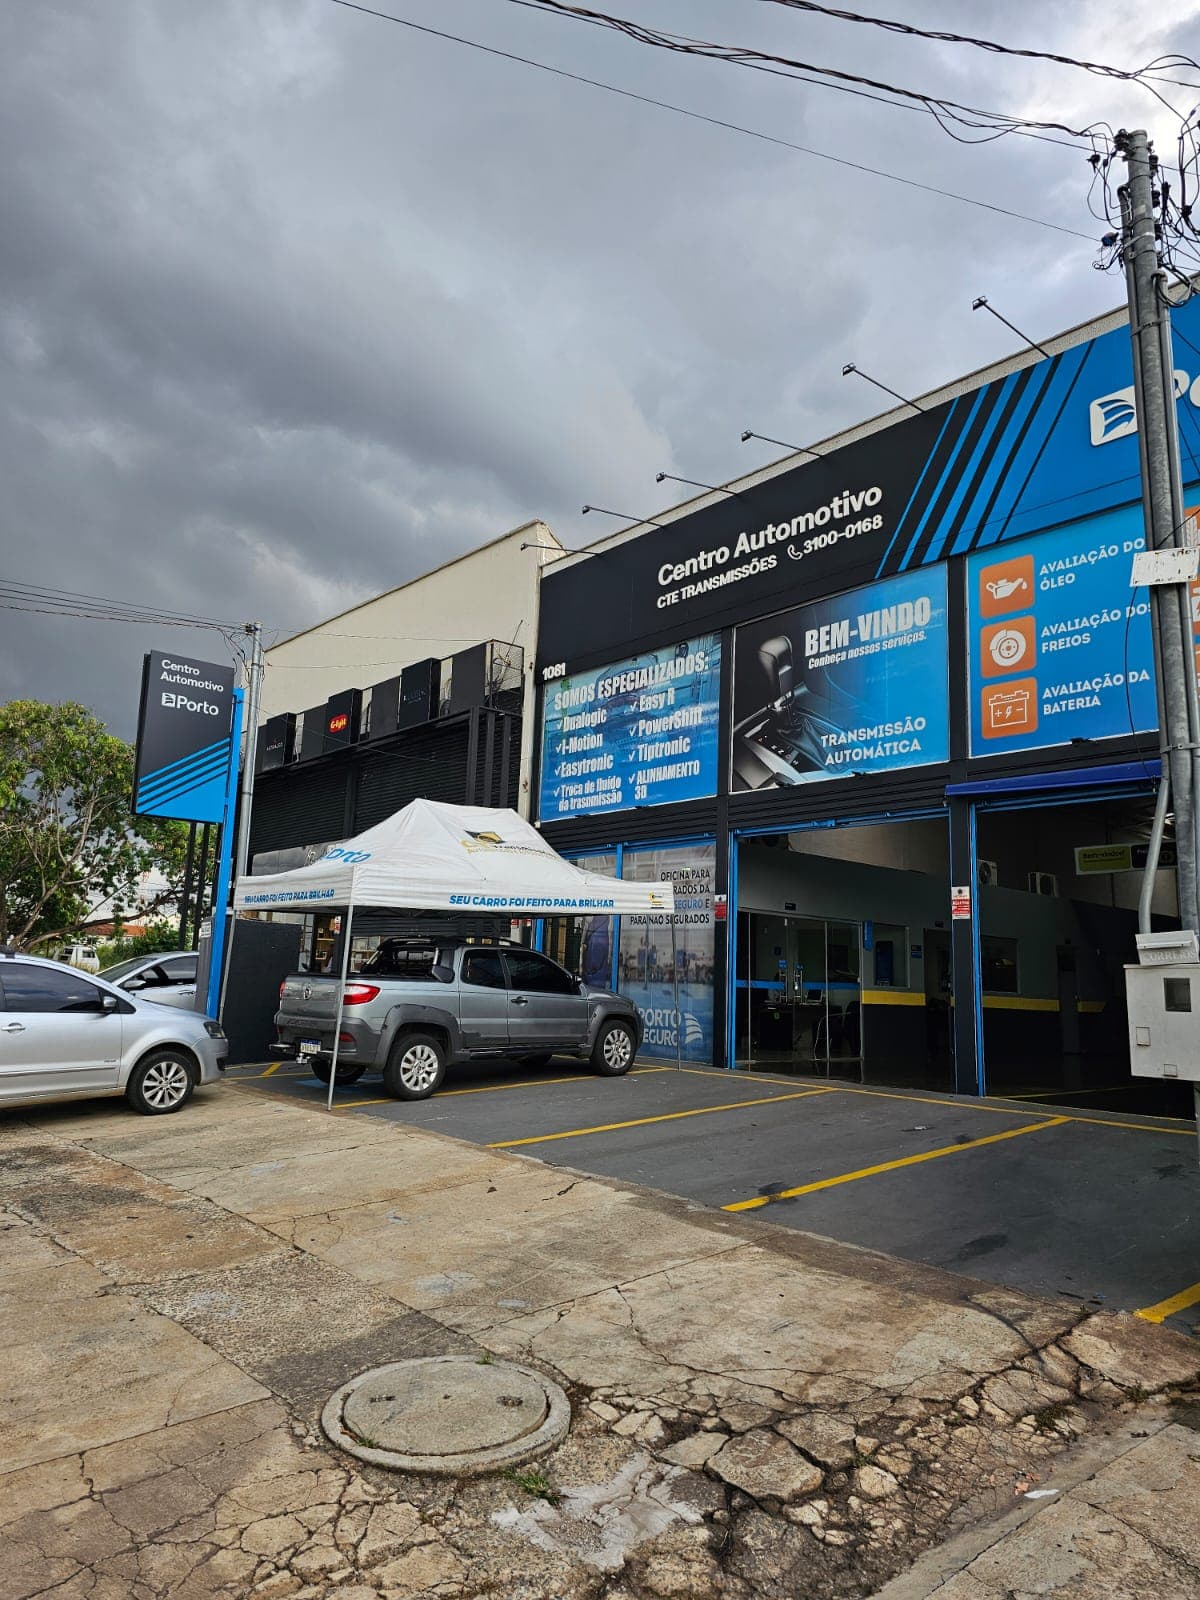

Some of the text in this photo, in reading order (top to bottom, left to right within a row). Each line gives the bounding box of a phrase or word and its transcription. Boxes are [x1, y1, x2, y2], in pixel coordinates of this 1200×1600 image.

[658, 486, 882, 585] Centro Automotivo
[657, 515, 883, 609] CTE TRANSMISSÕES 3100-0168
[1040, 537, 1145, 576] AVALIAÇÃO DO
[1040, 573, 1076, 591] ÓLEO
[805, 596, 931, 657] BEM-VINDO
[1041, 609, 1121, 638] AVALIAÇÃO
[808, 630, 927, 670] Conheça nossos serviços.
[1041, 633, 1091, 653] FREIOS
[161, 659, 200, 675] Centro
[542, 662, 566, 681] 1081
[160, 671, 224, 692] Automotivo
[554, 651, 709, 711] SOMOS ESPECIALIZADOS:
[1043, 669, 1150, 700] AVALIAÇÃO DA
[176, 695, 219, 716] Porto
[639, 687, 675, 712] Easy R
[1043, 695, 1101, 715] BATERIA
[563, 708, 607, 732] Dualogic
[638, 706, 703, 737] PowerShift
[821, 716, 926, 748] TRANSMISSÃO
[638, 736, 690, 762] Tiptronic
[825, 738, 922, 766] AUTOMÁTICA
[561, 753, 613, 778] Easytronic
[637, 760, 700, 785] ALINHAMENTO
[561, 783, 583, 798] Troca
[585, 781, 595, 795] de
[635, 785, 647, 800] 3D
[559, 798, 569, 812] da
[661, 869, 710, 881] OFICINA PARA
[673, 884, 710, 895] RADOS DA
[449, 895, 614, 908] SEU CARRO FOI FEITO PARA BRILHAR
[674, 898, 702, 909] SEGURO
[705, 898, 710, 909] E
[631, 915, 646, 925] PARA
[643, 1028, 679, 1047] EGURO
